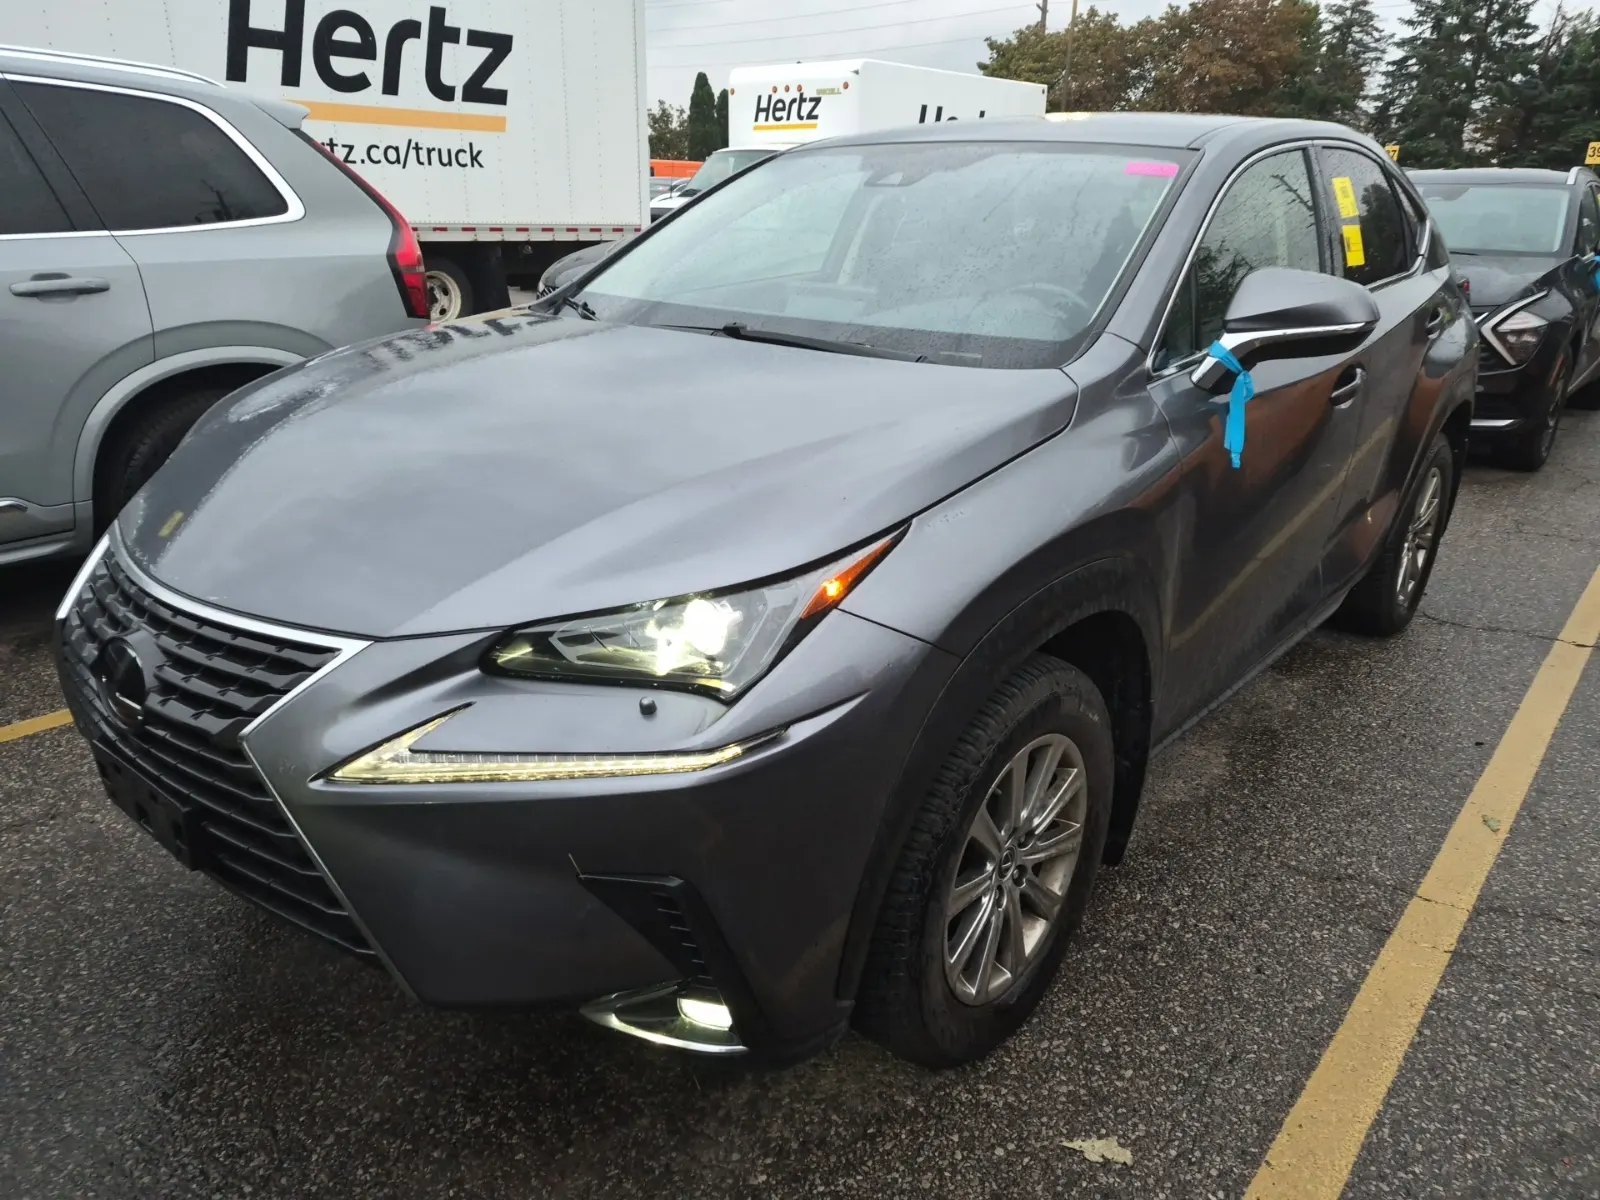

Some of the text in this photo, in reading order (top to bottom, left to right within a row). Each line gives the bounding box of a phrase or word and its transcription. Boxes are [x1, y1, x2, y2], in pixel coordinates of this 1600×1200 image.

[226, 0, 513, 106] Hertz
[754, 92, 822, 122] Hertz
[320, 137, 484, 169] tz.ca/truck
